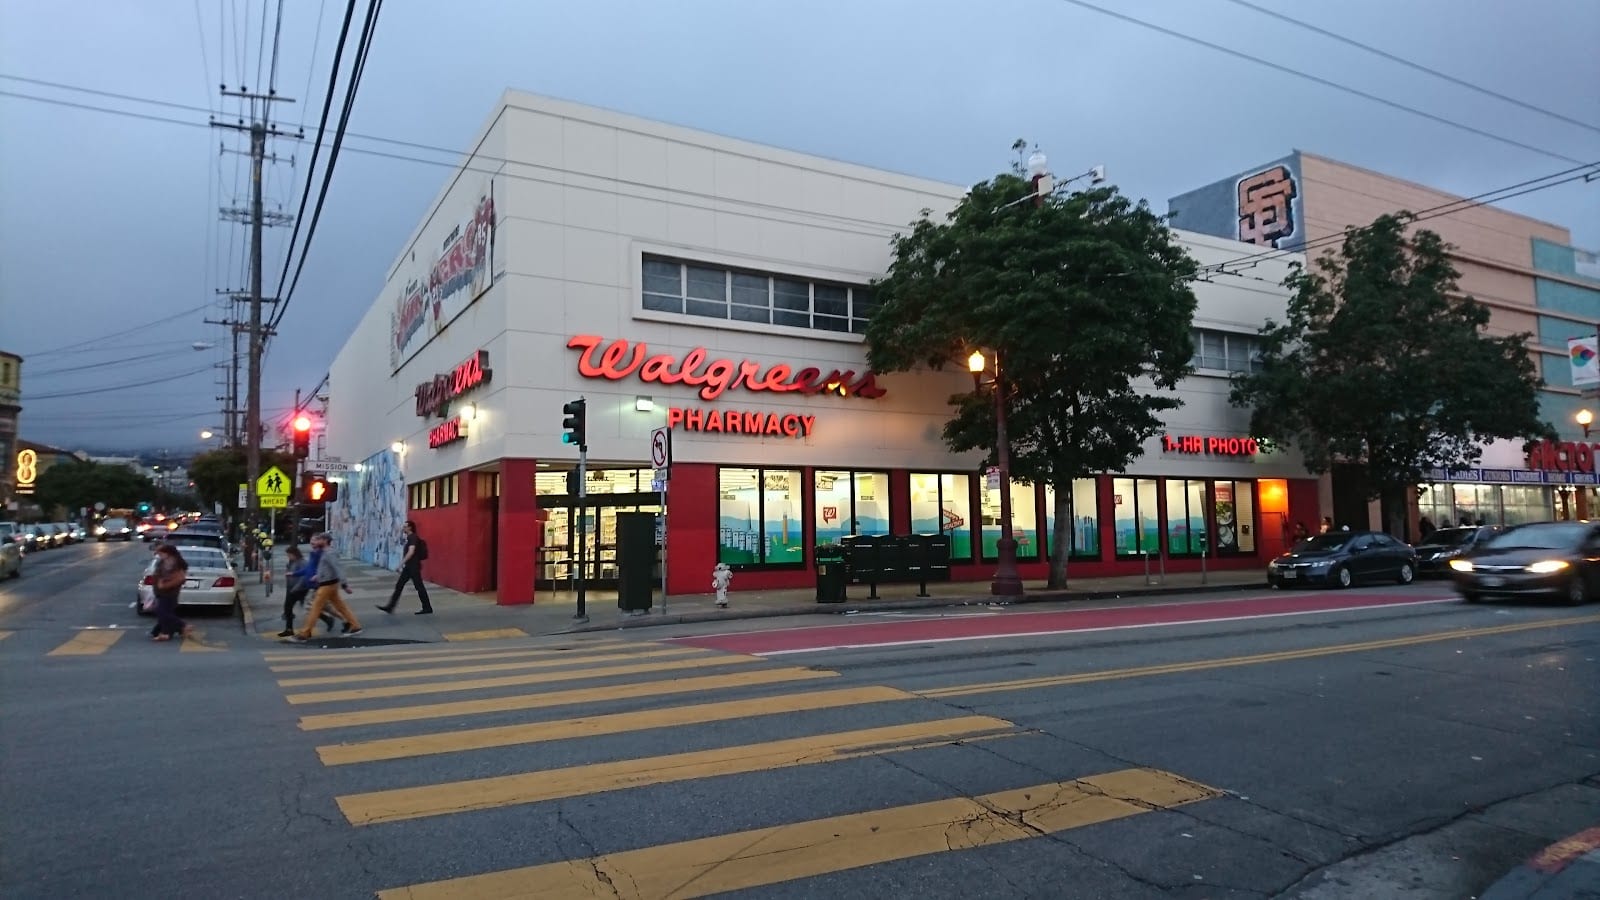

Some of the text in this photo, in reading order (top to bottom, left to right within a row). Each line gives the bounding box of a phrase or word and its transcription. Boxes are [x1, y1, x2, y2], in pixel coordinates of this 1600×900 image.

[567, 335, 887, 400] Walgreens
[669, 407, 816, 436] PHARMACY
[1164, 434, 1258, 455] 1-HR PHOTO
[316, 463, 348, 471] MISSION
